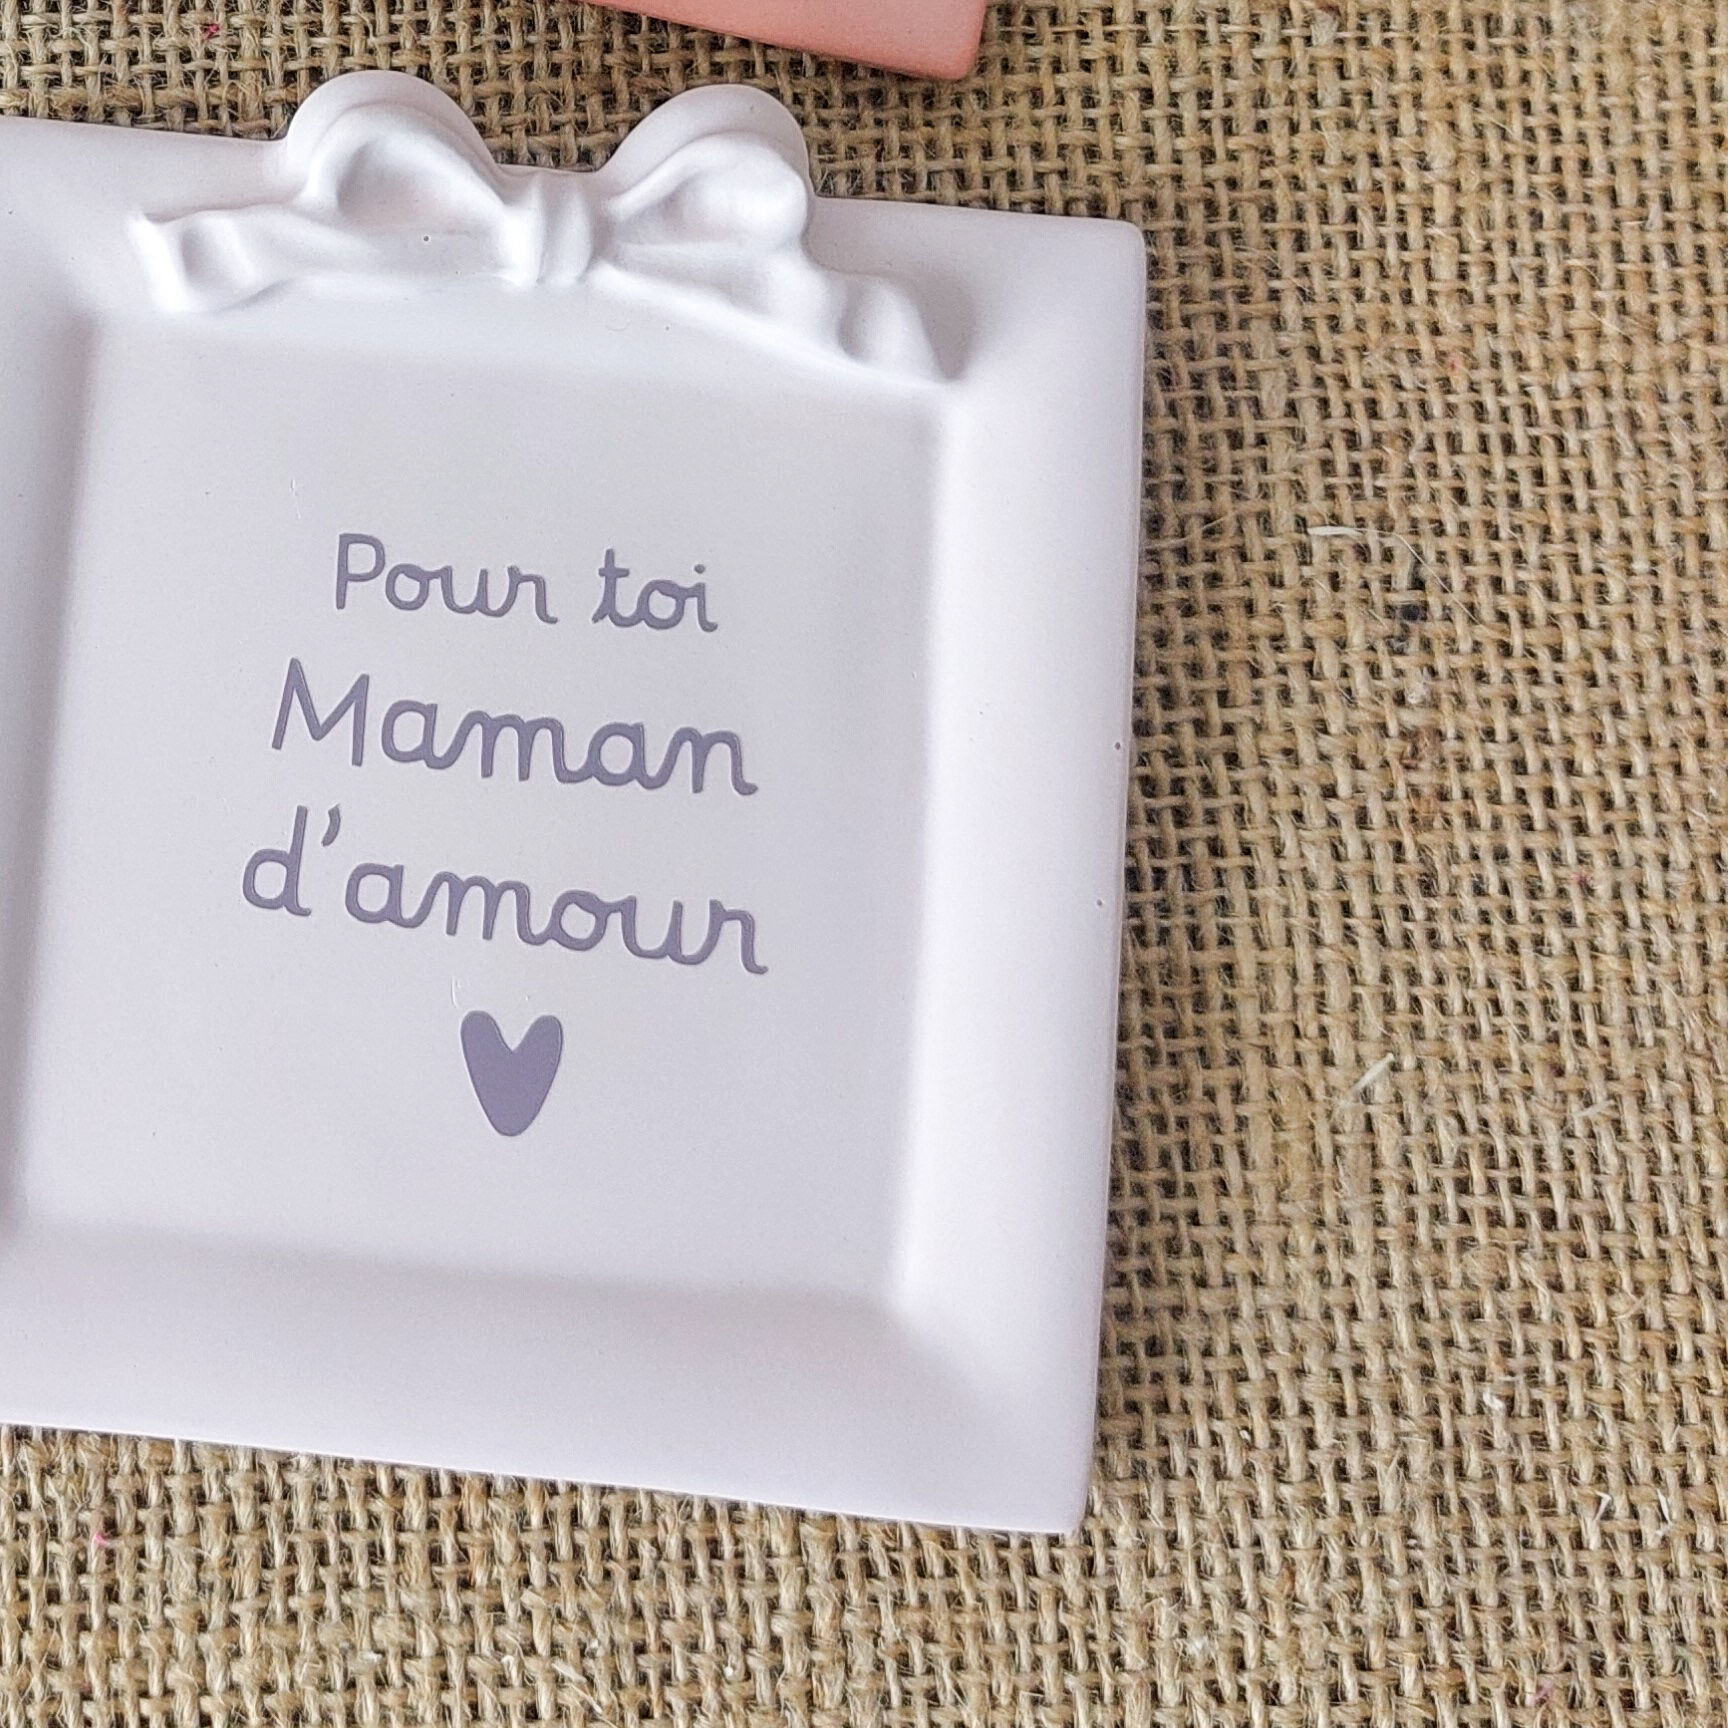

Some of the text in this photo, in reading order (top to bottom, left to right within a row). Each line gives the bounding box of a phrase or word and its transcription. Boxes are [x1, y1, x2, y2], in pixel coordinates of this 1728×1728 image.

[336, 533, 718, 632] Pour toi
[271, 657, 758, 795] Maman
[242, 804, 768, 974] d'amour
